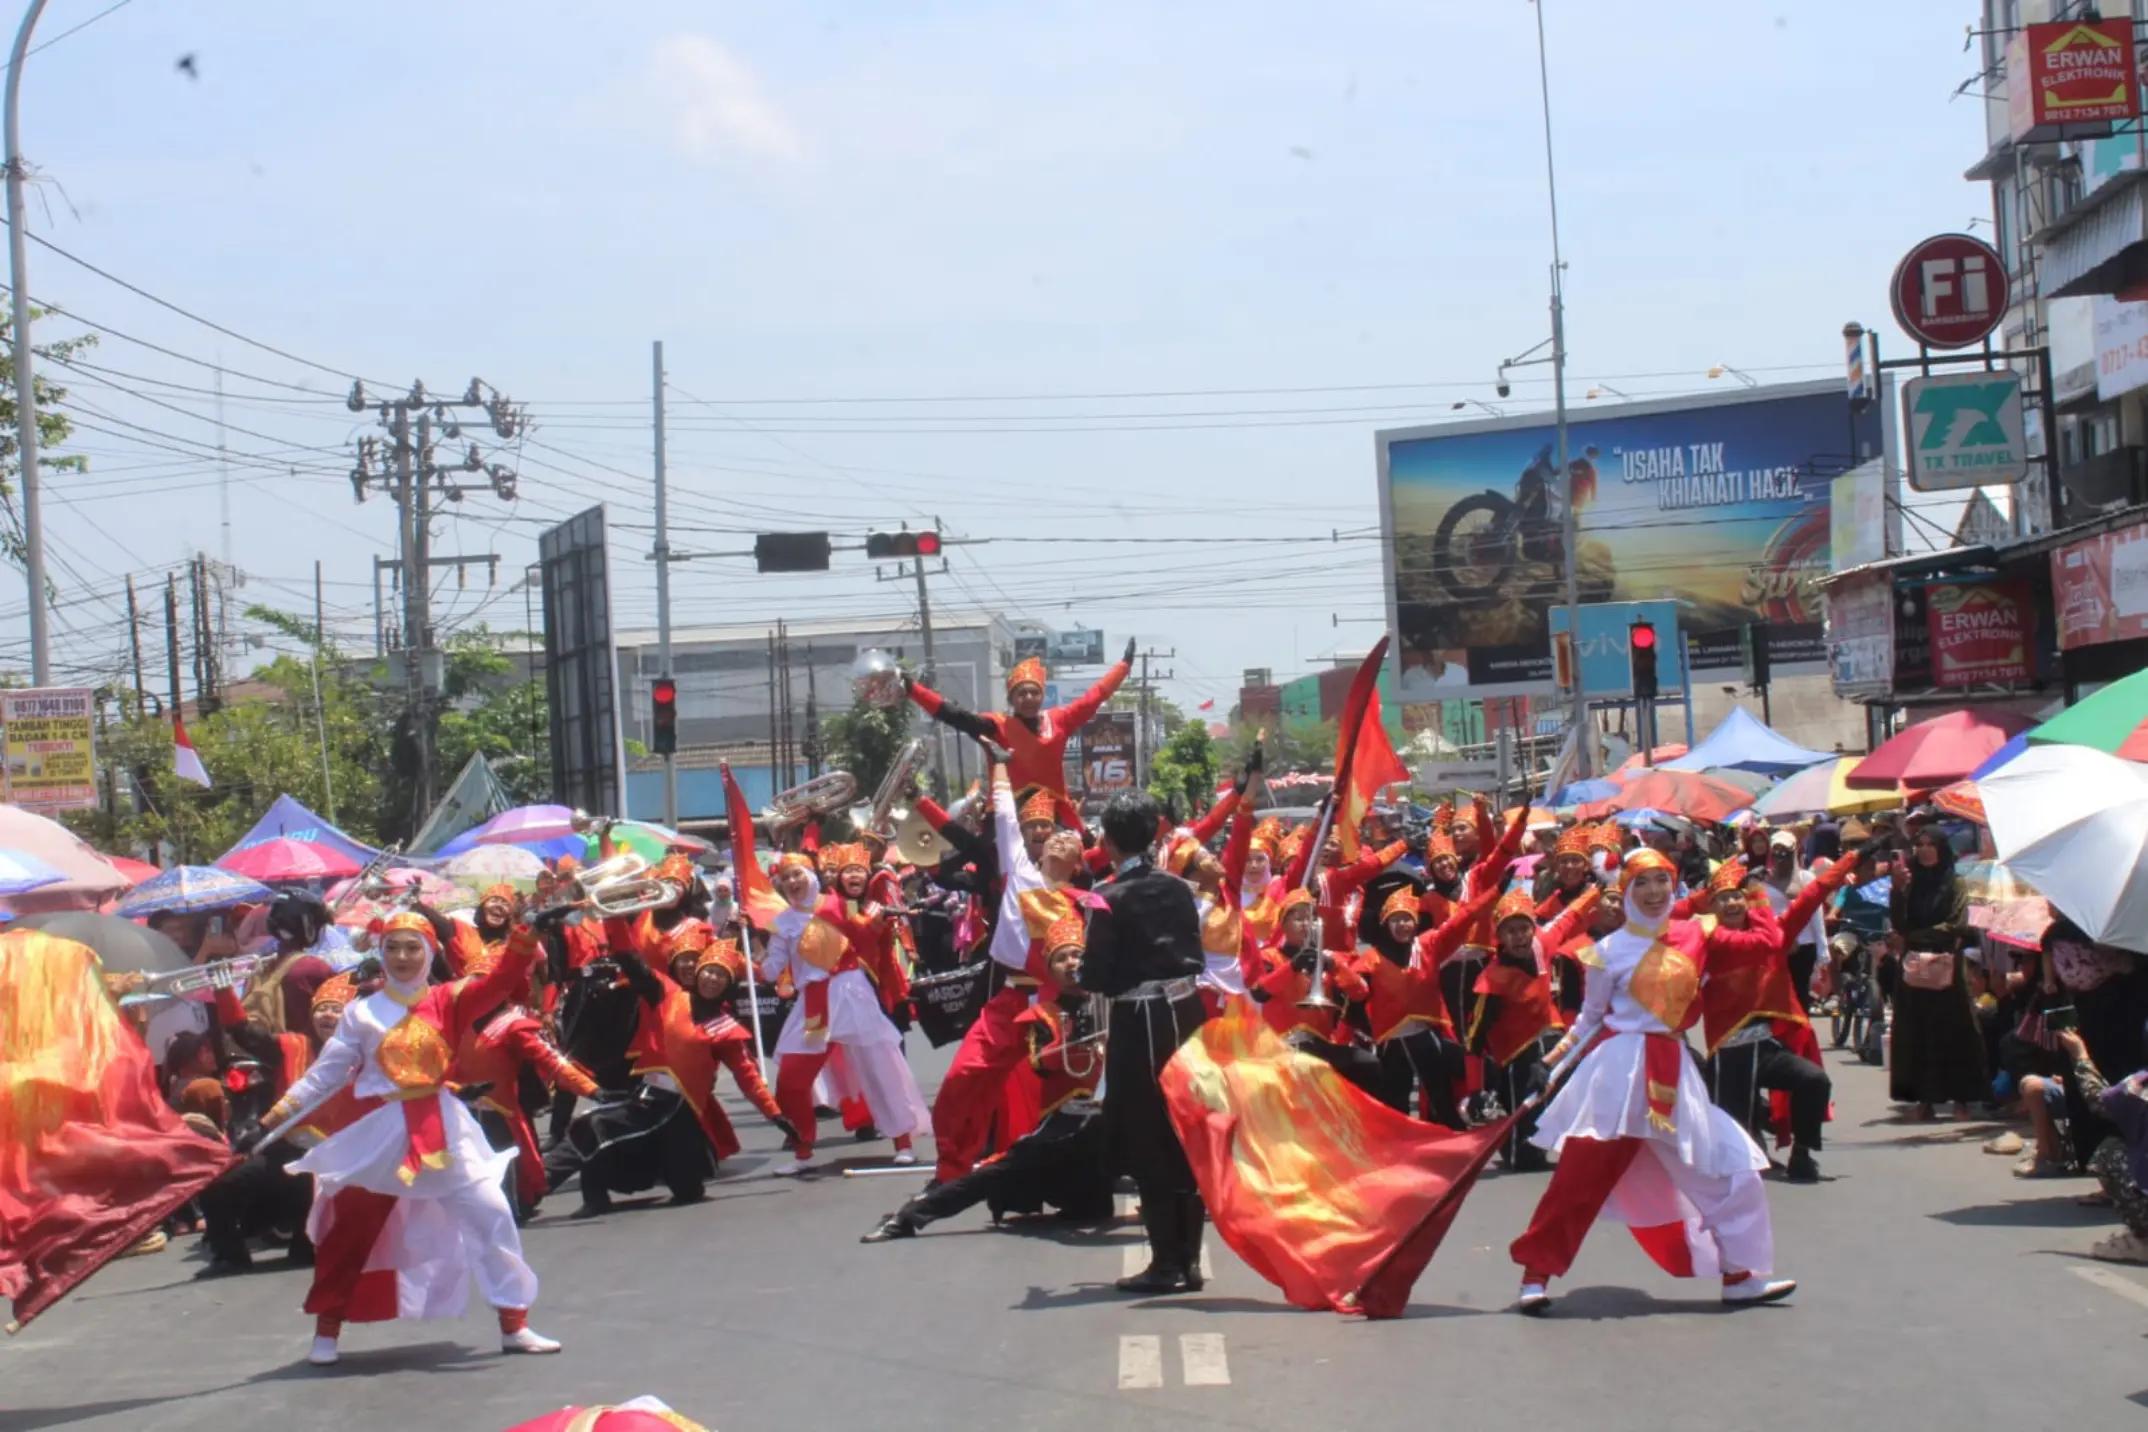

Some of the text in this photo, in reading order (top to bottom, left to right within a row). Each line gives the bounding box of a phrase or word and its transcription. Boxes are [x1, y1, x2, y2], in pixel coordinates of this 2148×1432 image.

[2045, 48, 2123, 70] ERWAN
[2040, 67, 2127, 88] ELEKTRONIK
[1921, 255, 1990, 316] Fi
[1689, 442, 1725, 475] TAK
[1952, 450, 2016, 469] TRAVEL
[1658, 471, 1744, 509] KHIANATI
[1941, 608, 2019, 631] ERWAN
[1938, 628, 2023, 649] ELEKTRONIK
[8, 719, 88, 731] TAMBAH TINGGI
[9, 732, 48, 742] BADAN
